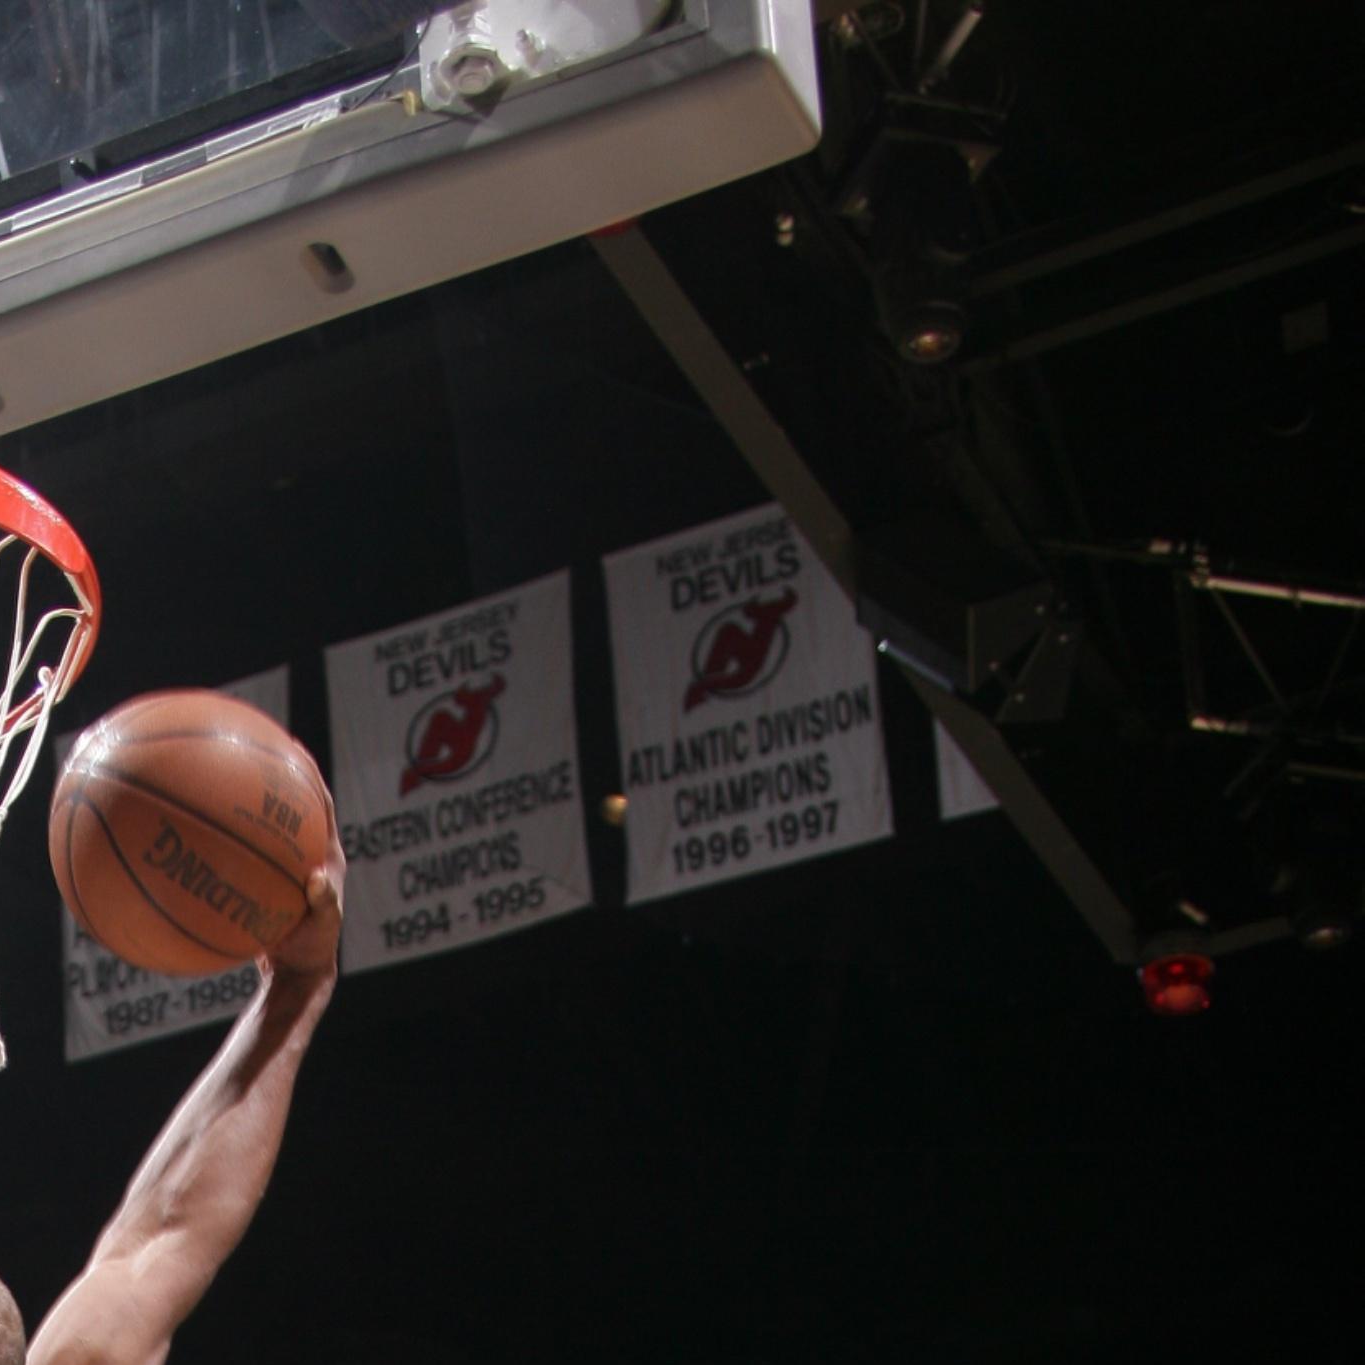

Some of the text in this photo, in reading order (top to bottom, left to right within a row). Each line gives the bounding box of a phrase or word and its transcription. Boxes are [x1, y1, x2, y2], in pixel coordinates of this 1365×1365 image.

[656, 515, 789, 576] NEW JERSE
[670, 544, 802, 612] DEVILS
[375, 599, 519, 662] NEW JERSEY
[387, 628, 512, 697] DEVILS
[628, 684, 873, 787] ATLANTIC DIVISION
[342, 806, 432, 861] EASTERN
[436, 758, 574, 838] CONFERENCE
[675, 751, 832, 829] CHAMPIONS
[398, 829, 522, 900] CHAMPIONS
